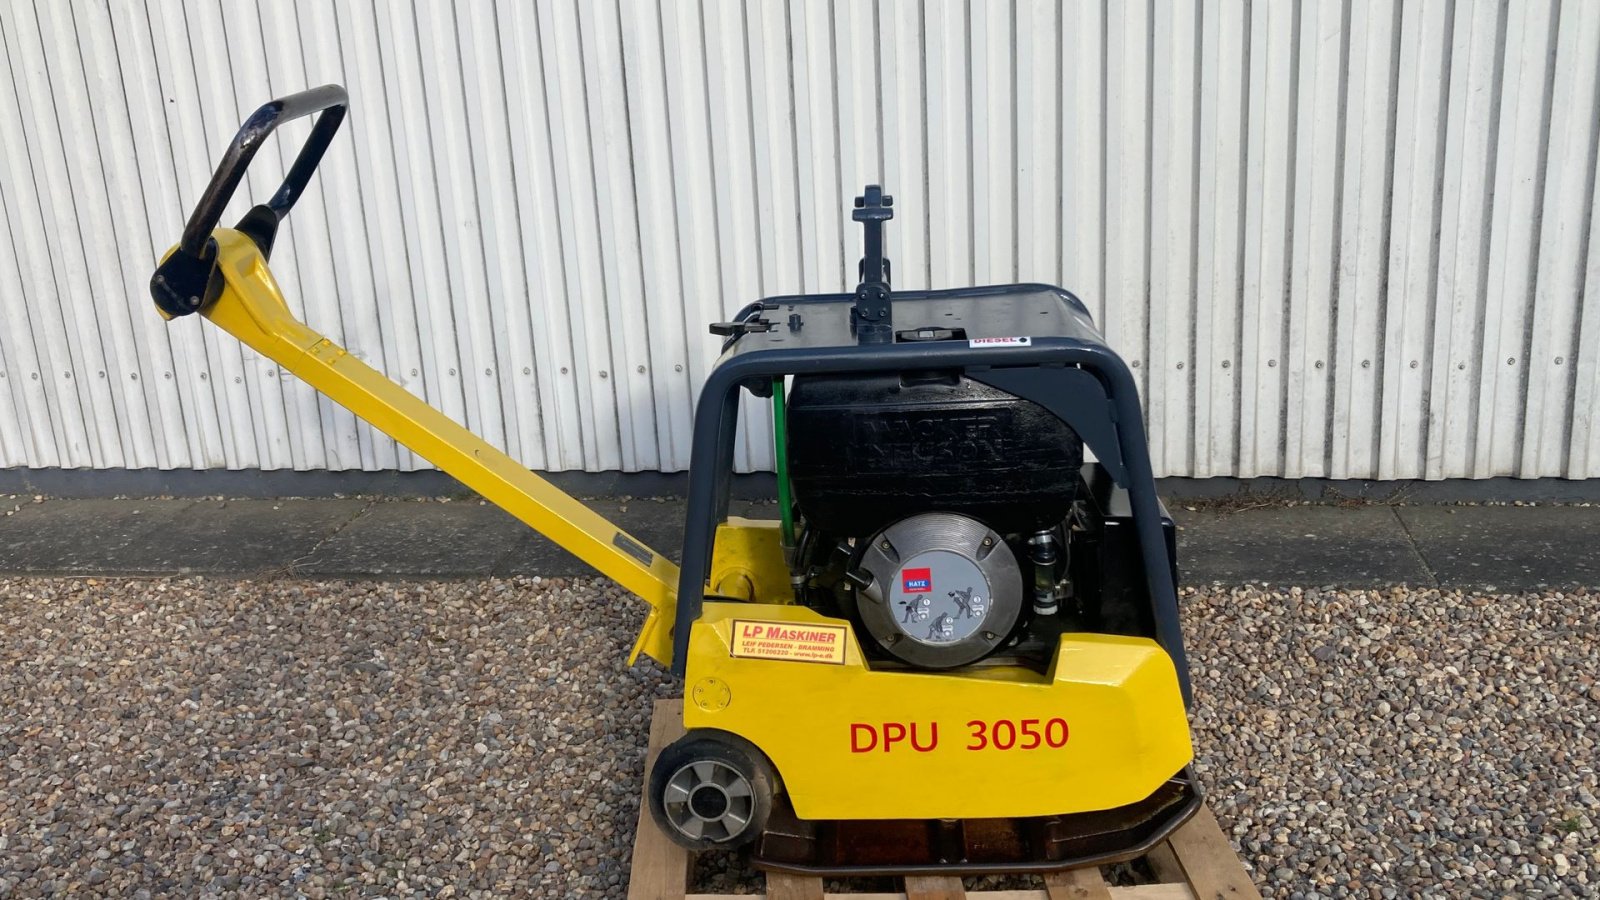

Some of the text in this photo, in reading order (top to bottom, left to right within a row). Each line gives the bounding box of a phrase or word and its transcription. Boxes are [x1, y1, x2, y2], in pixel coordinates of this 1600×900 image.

[908, 580, 926, 588] HATZ
[743, 625, 763, 638] LP
[757, 641, 793, 650] PEDERSEN
[798, 645, 835, 653] BRAMMING
[850, 718, 1069, 753] DPU 3050
